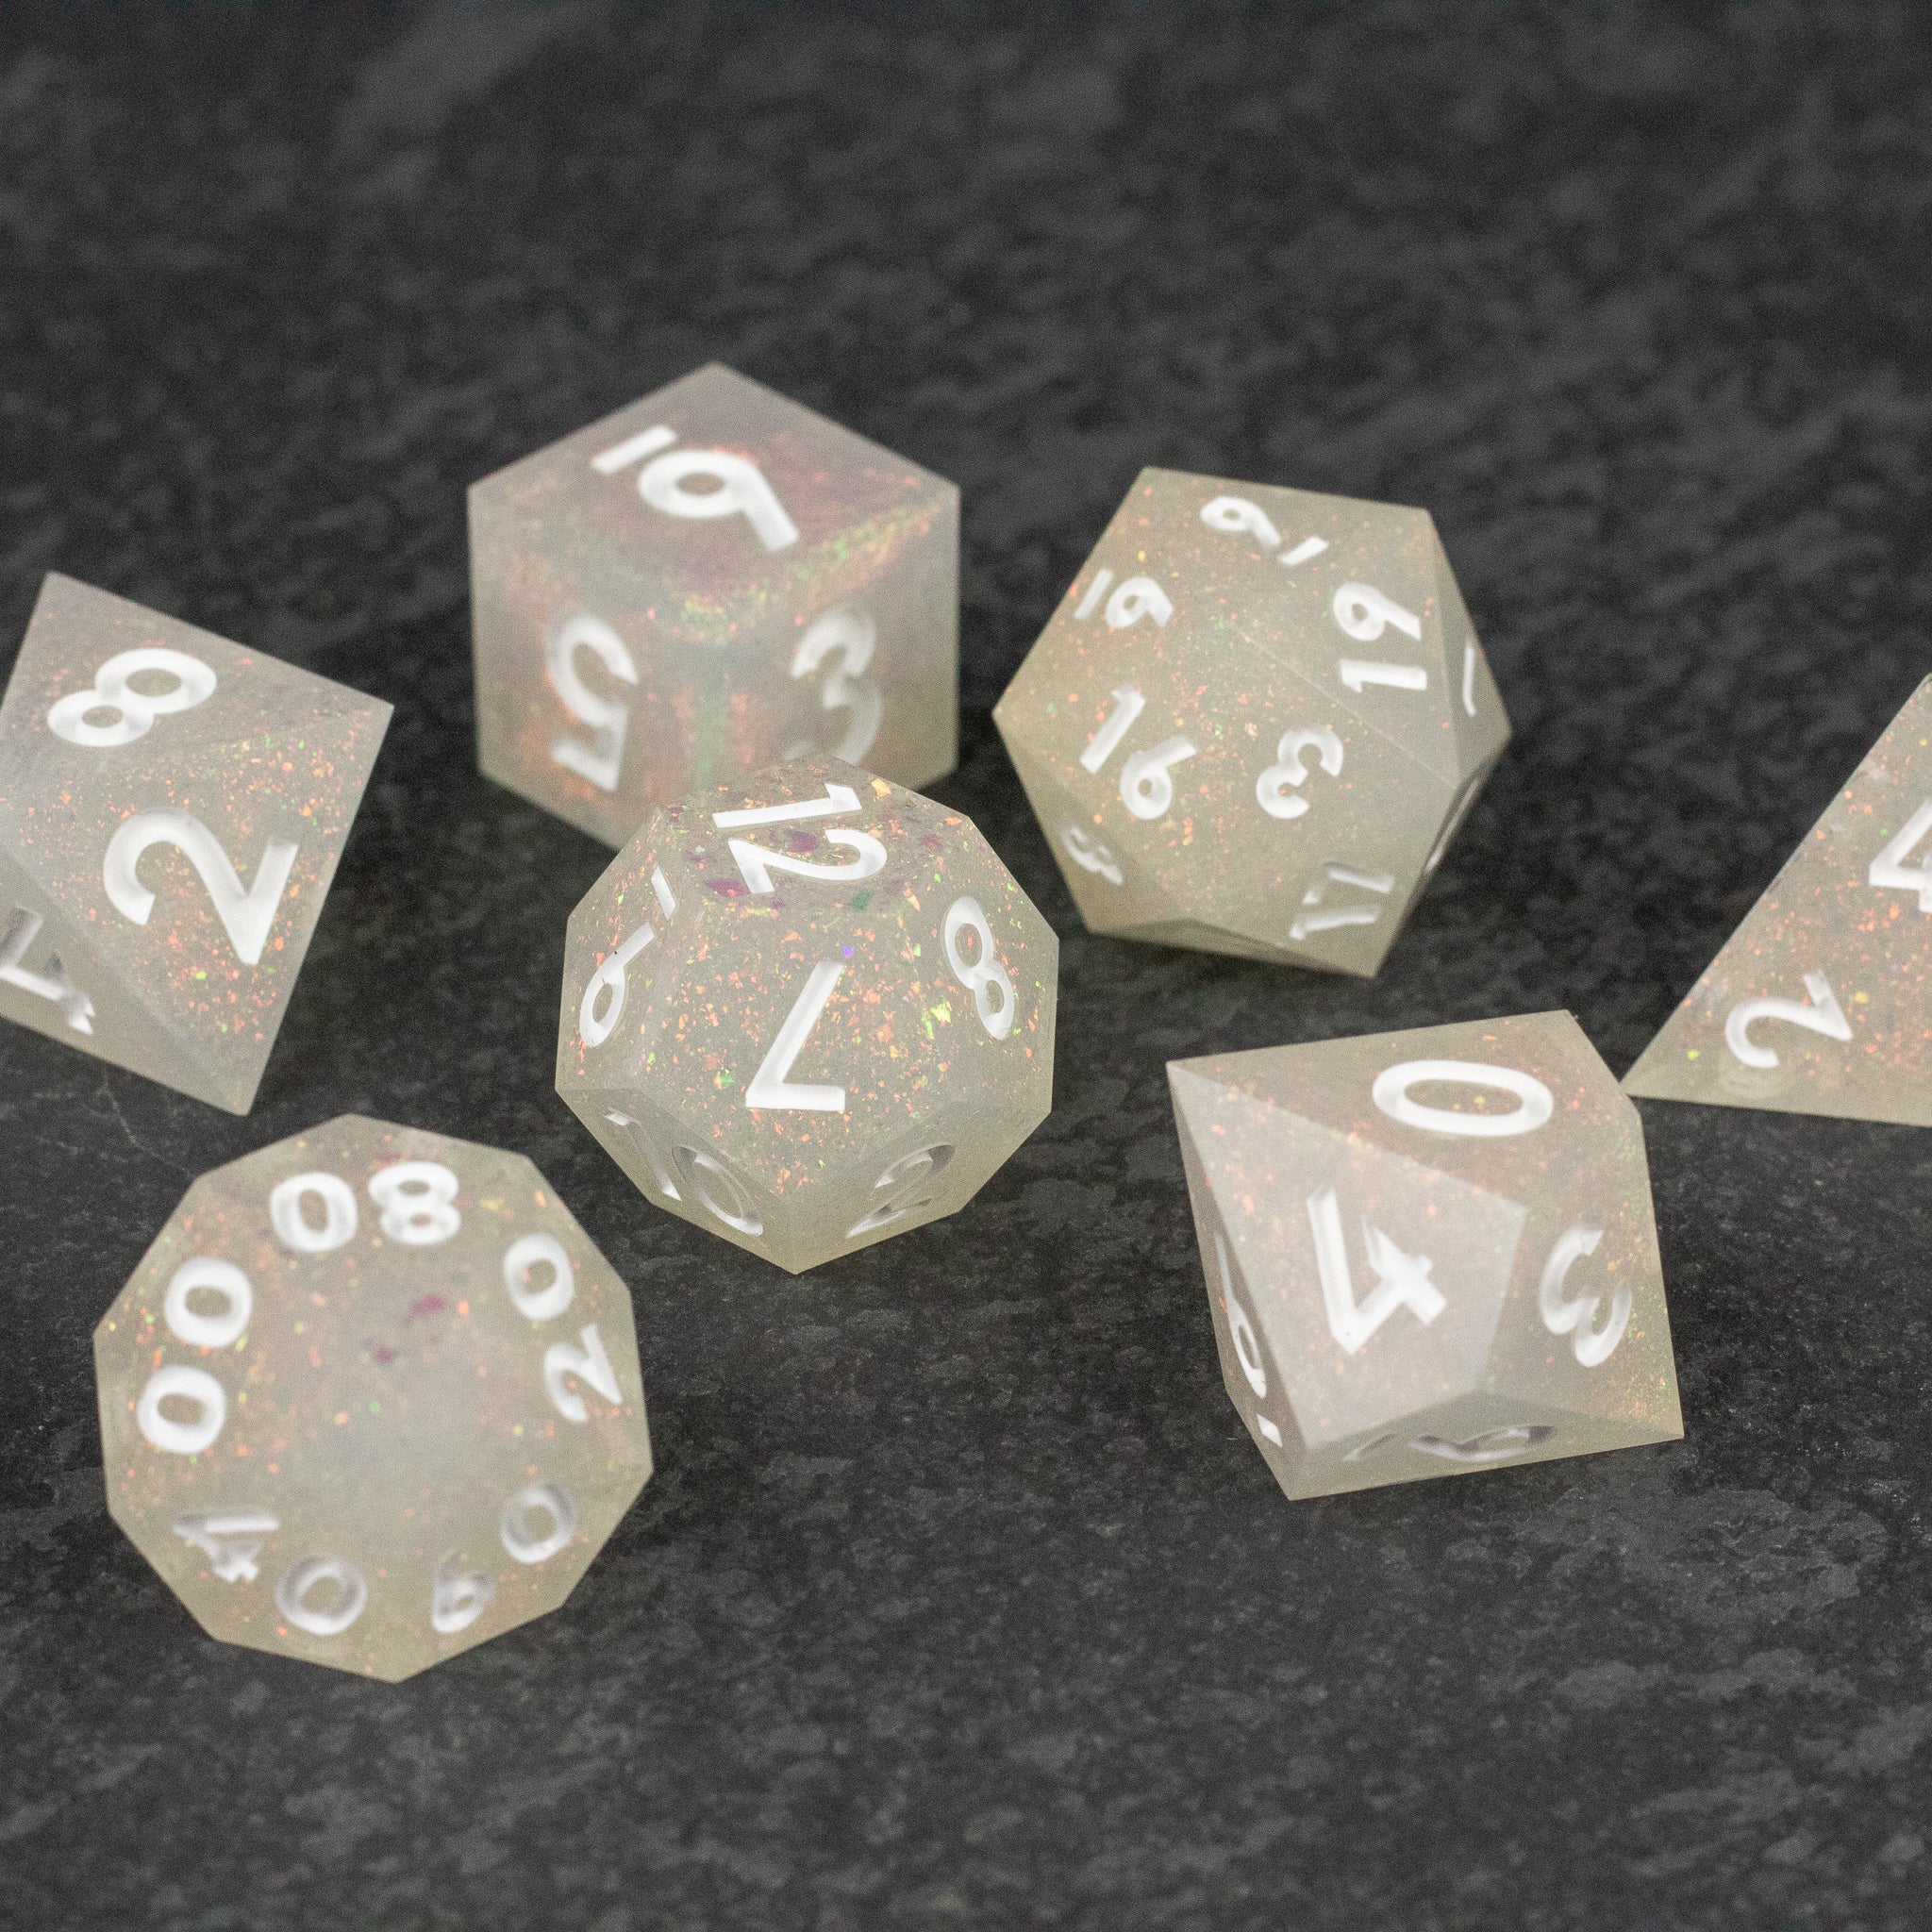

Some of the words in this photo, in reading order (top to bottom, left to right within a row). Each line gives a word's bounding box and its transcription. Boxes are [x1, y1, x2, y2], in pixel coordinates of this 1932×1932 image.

[47, 648, 217, 747] 8
[1332, 581, 1428, 692] 19
[1079, 685, 1197, 822] 16
[1256, 726, 1344, 819] 3
[103, 808, 299, 966] 2
[712, 783, 887, 894] 12
[745, 960, 846, 1111] 7
[944, 896, 1015, 1041] 8
[1725, 970, 1854, 1069] 2
[1372, 1059, 1554, 1137] 0
[502, 1232, 623, 1423] 20
[1306, 1185, 1447, 1356] 4
[1539, 1224, 1633, 1368] 3
[137, 1256, 255, 1455] 00
